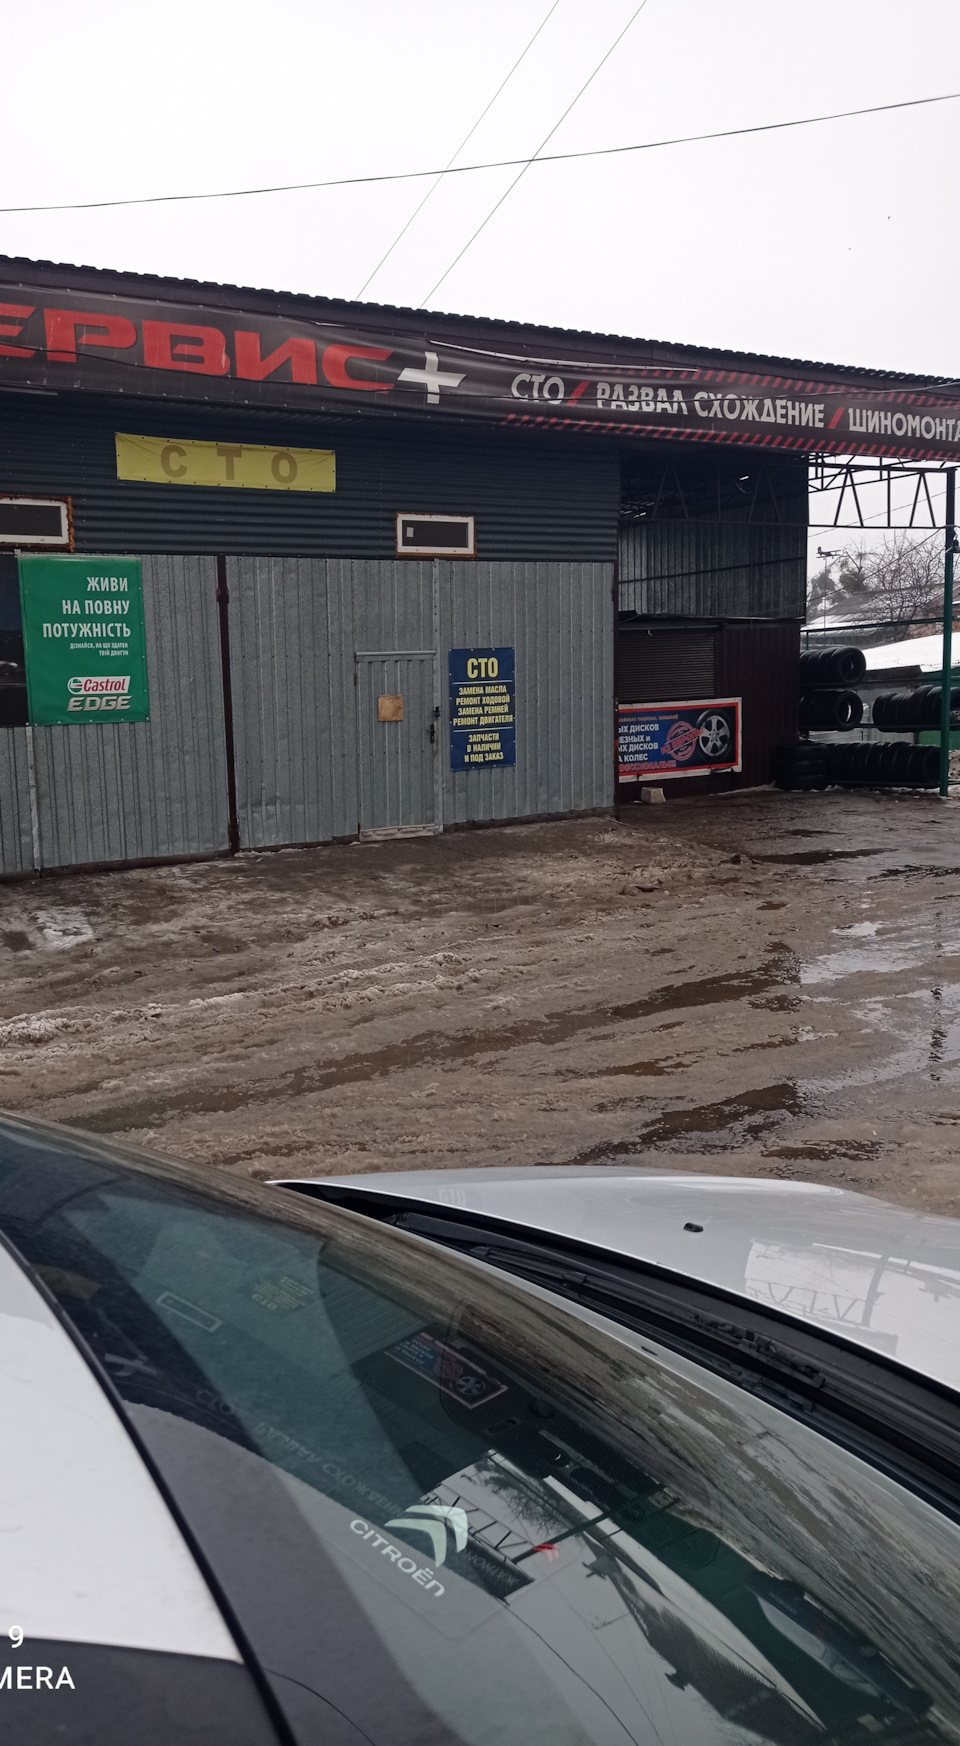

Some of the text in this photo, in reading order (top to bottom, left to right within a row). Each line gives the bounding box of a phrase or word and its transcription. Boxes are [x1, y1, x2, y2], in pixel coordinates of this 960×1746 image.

[511, 373, 565, 405] СТО
[596, 382, 688, 414] РАЗВАЛ
[694, 391, 825, 428] СХОЖДЕНИЕ
[160, 444, 298, 484] СТО
[86, 577, 128, 592] ЖИВИ
[62, 600, 130, 615] НА ПОВНУ
[42, 623, 131, 638] ПОТУЖНІСТЬ
[467, 657, 499, 679] СТО
[83, 678, 126, 692] Castrol
[459, 685, 507, 695] ЗАМЕНА МАСЛА
[67, 696, 132, 712] EDGE
[456, 694, 510, 706] РЕМОНТ ХОДОВОЙ
[458, 704, 509, 716] ЗАМЕНА РЕМНЕЙ
[453, 715, 513, 726] РЕМОНТ ДВИГАТЕЛЯ
[629, 723, 660, 734] ДИСКОВ
[468, 733, 500, 743] ЗАПЧАСТИ
[467, 742, 501, 752] В НАЛИЧИИ
[628, 742, 659, 752] ДИСКОВ
[464, 752, 504, 763] И ПОД ЗАКАЗ
[624, 753, 649, 762] КОЛЕС
